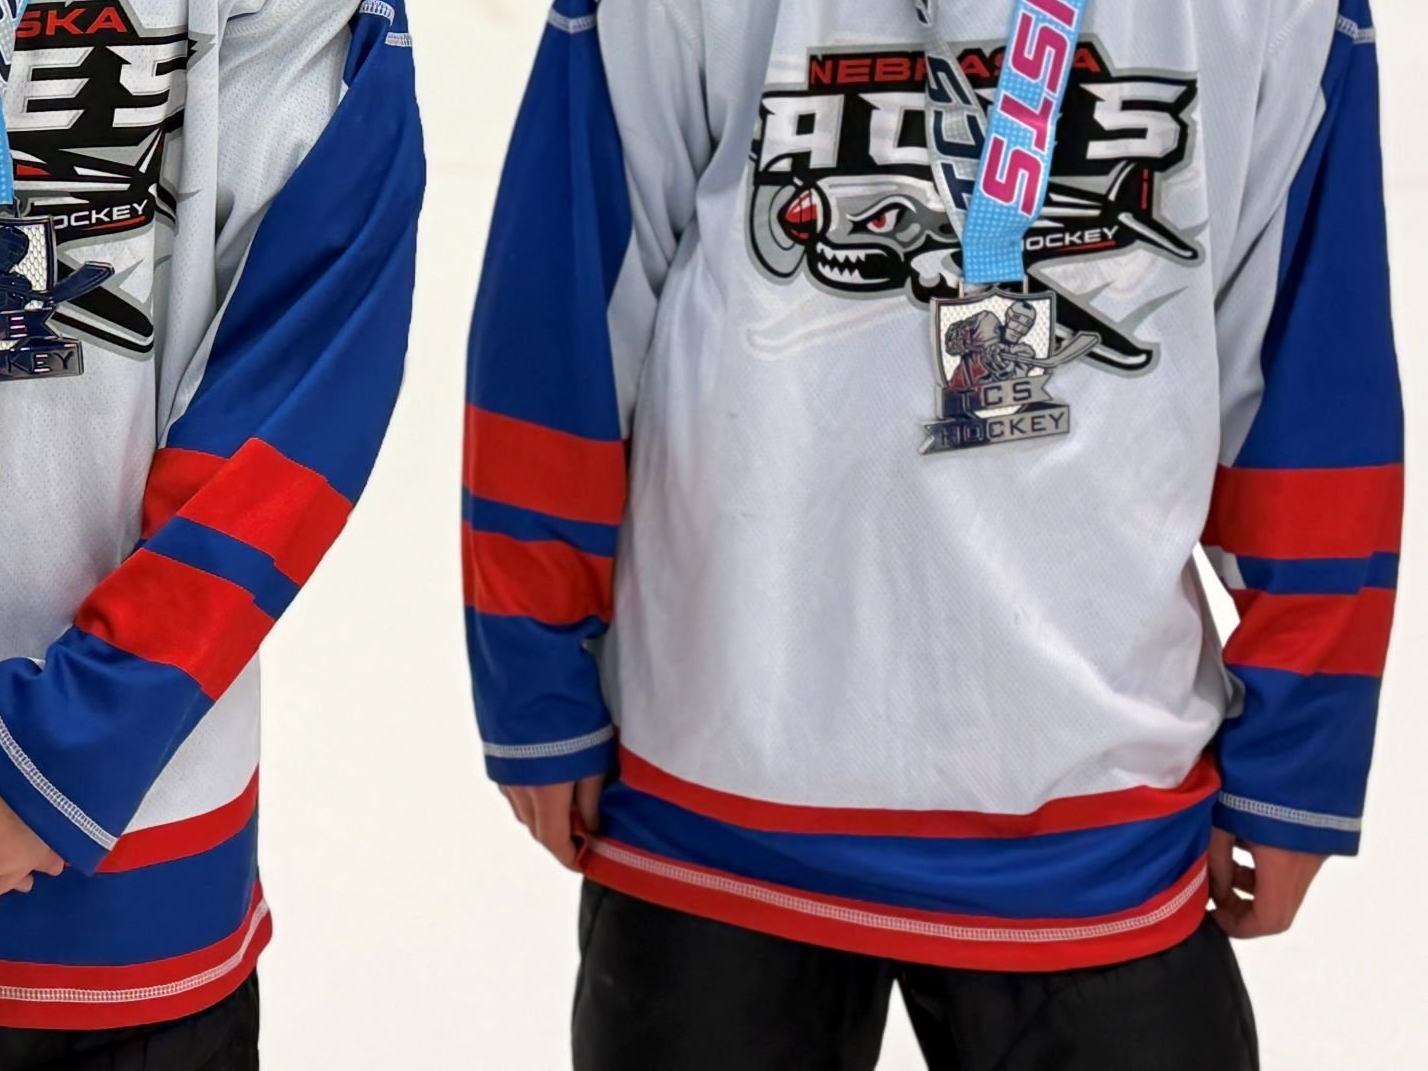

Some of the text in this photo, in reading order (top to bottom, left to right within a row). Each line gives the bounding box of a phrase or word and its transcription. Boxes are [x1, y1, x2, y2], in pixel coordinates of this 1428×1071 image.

[760, 82, 1188, 173] ACS
[52, 199, 149, 230] OCKEY
[1021, 225, 1119, 251] OCKEY
